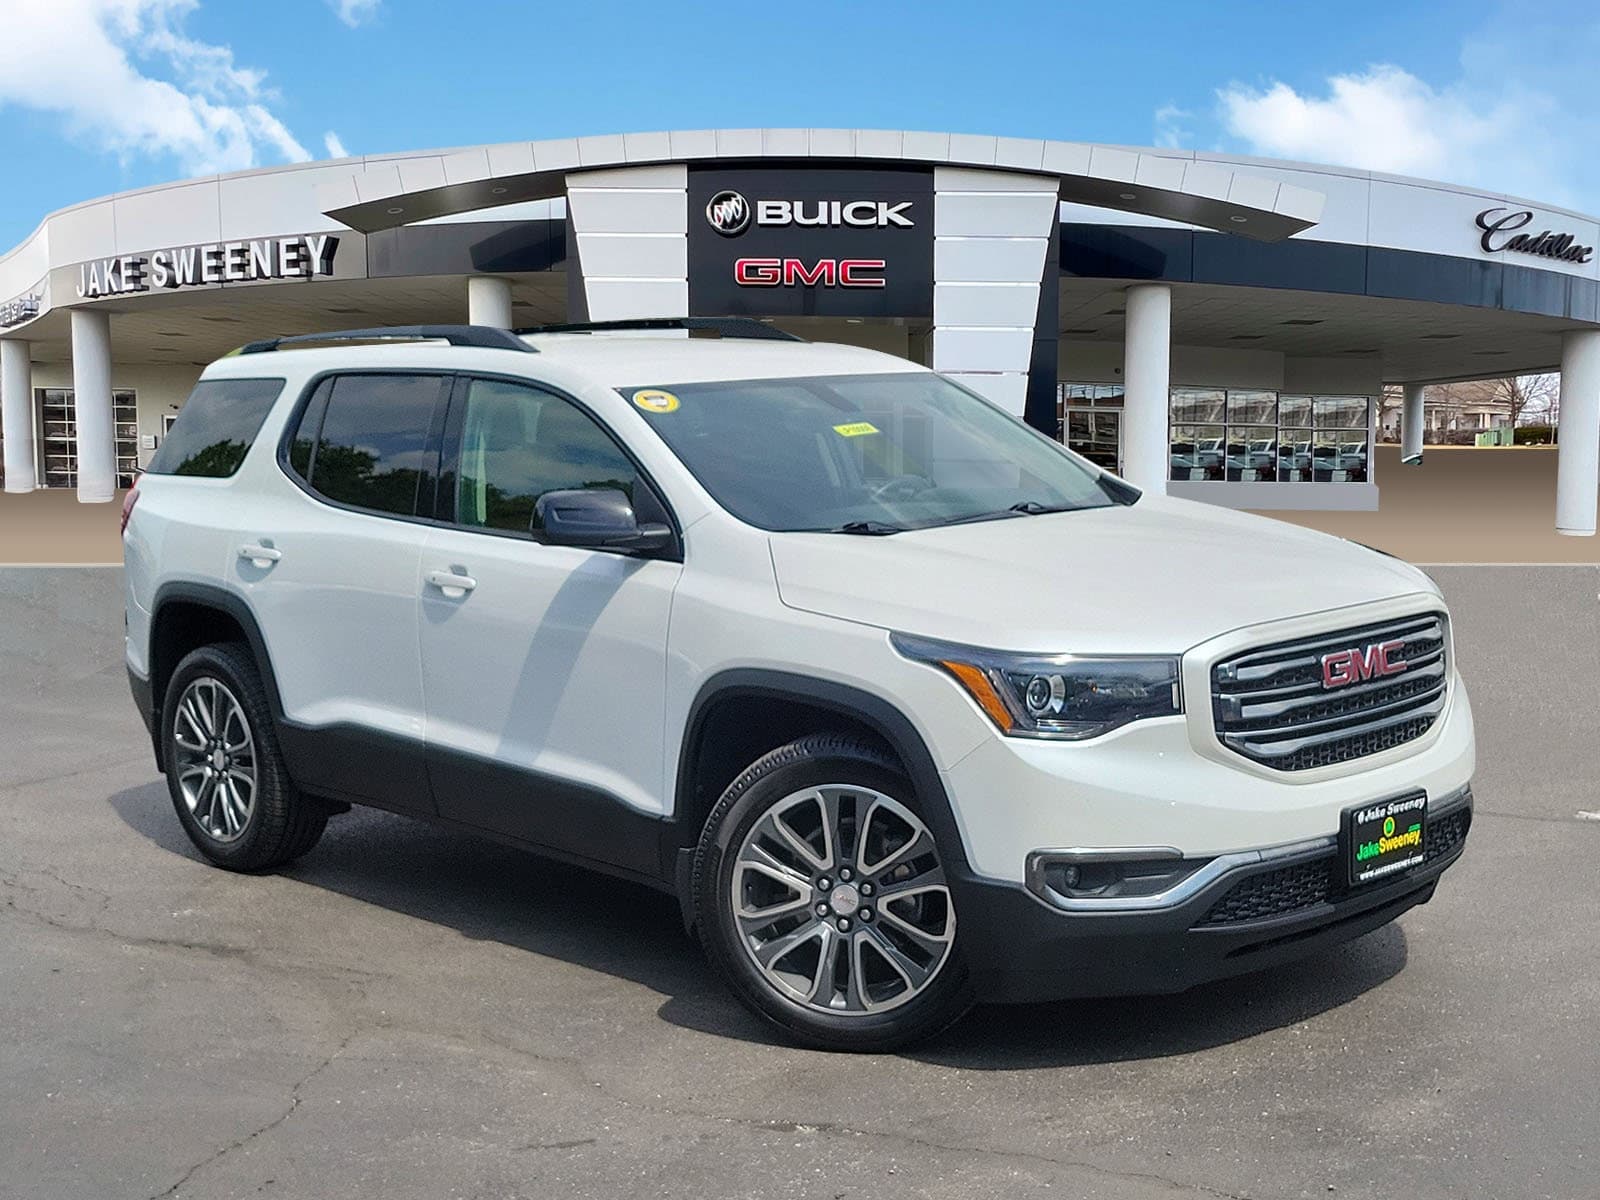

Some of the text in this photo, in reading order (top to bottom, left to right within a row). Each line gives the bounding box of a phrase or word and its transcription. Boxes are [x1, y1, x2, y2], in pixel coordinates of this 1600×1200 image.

[757, 200, 915, 227] BUICK
[1475, 207, 1593, 263] Cadillac
[77, 235, 333, 298] JAKE SWEENEY
[735, 257, 886, 287] GMC
[1321, 640, 1407, 689] GMC
